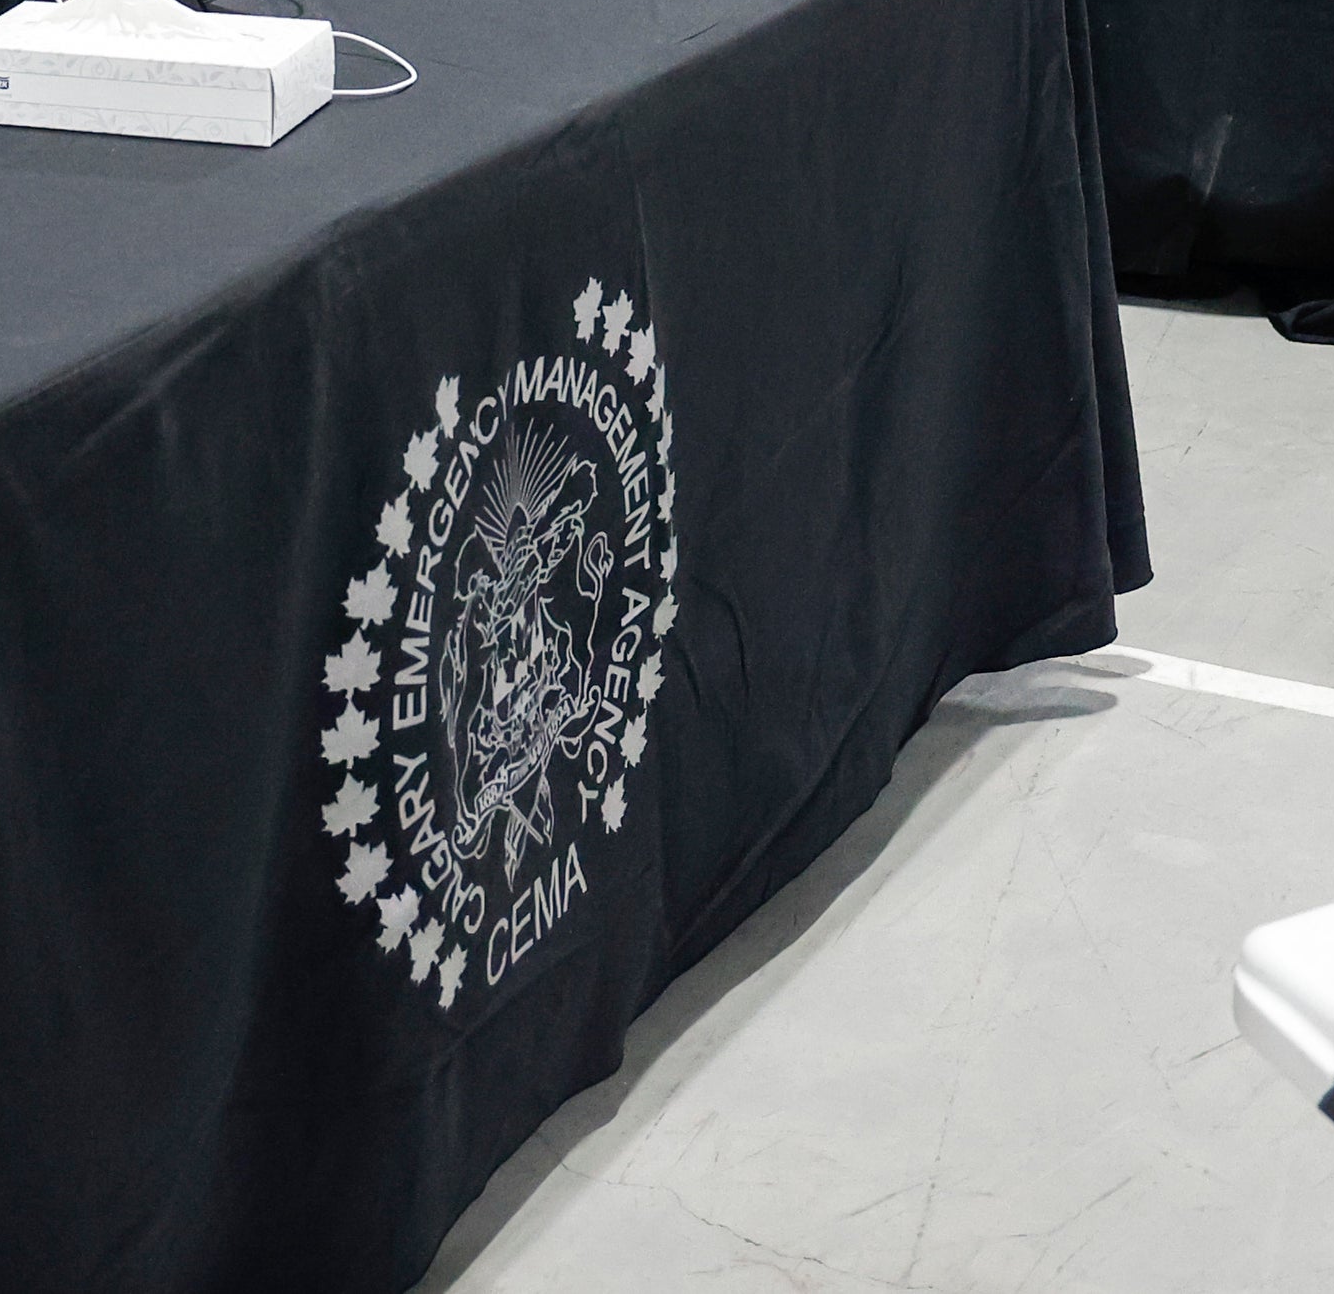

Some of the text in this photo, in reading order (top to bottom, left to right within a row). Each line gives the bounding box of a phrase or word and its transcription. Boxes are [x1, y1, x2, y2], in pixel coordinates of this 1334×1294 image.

[393, 370, 511, 730] EMERGENCY
[514, 356, 651, 571] MANAGEMENT
[577, 587, 651, 824] AGENCY
[486, 842, 588, 986] CEMA
